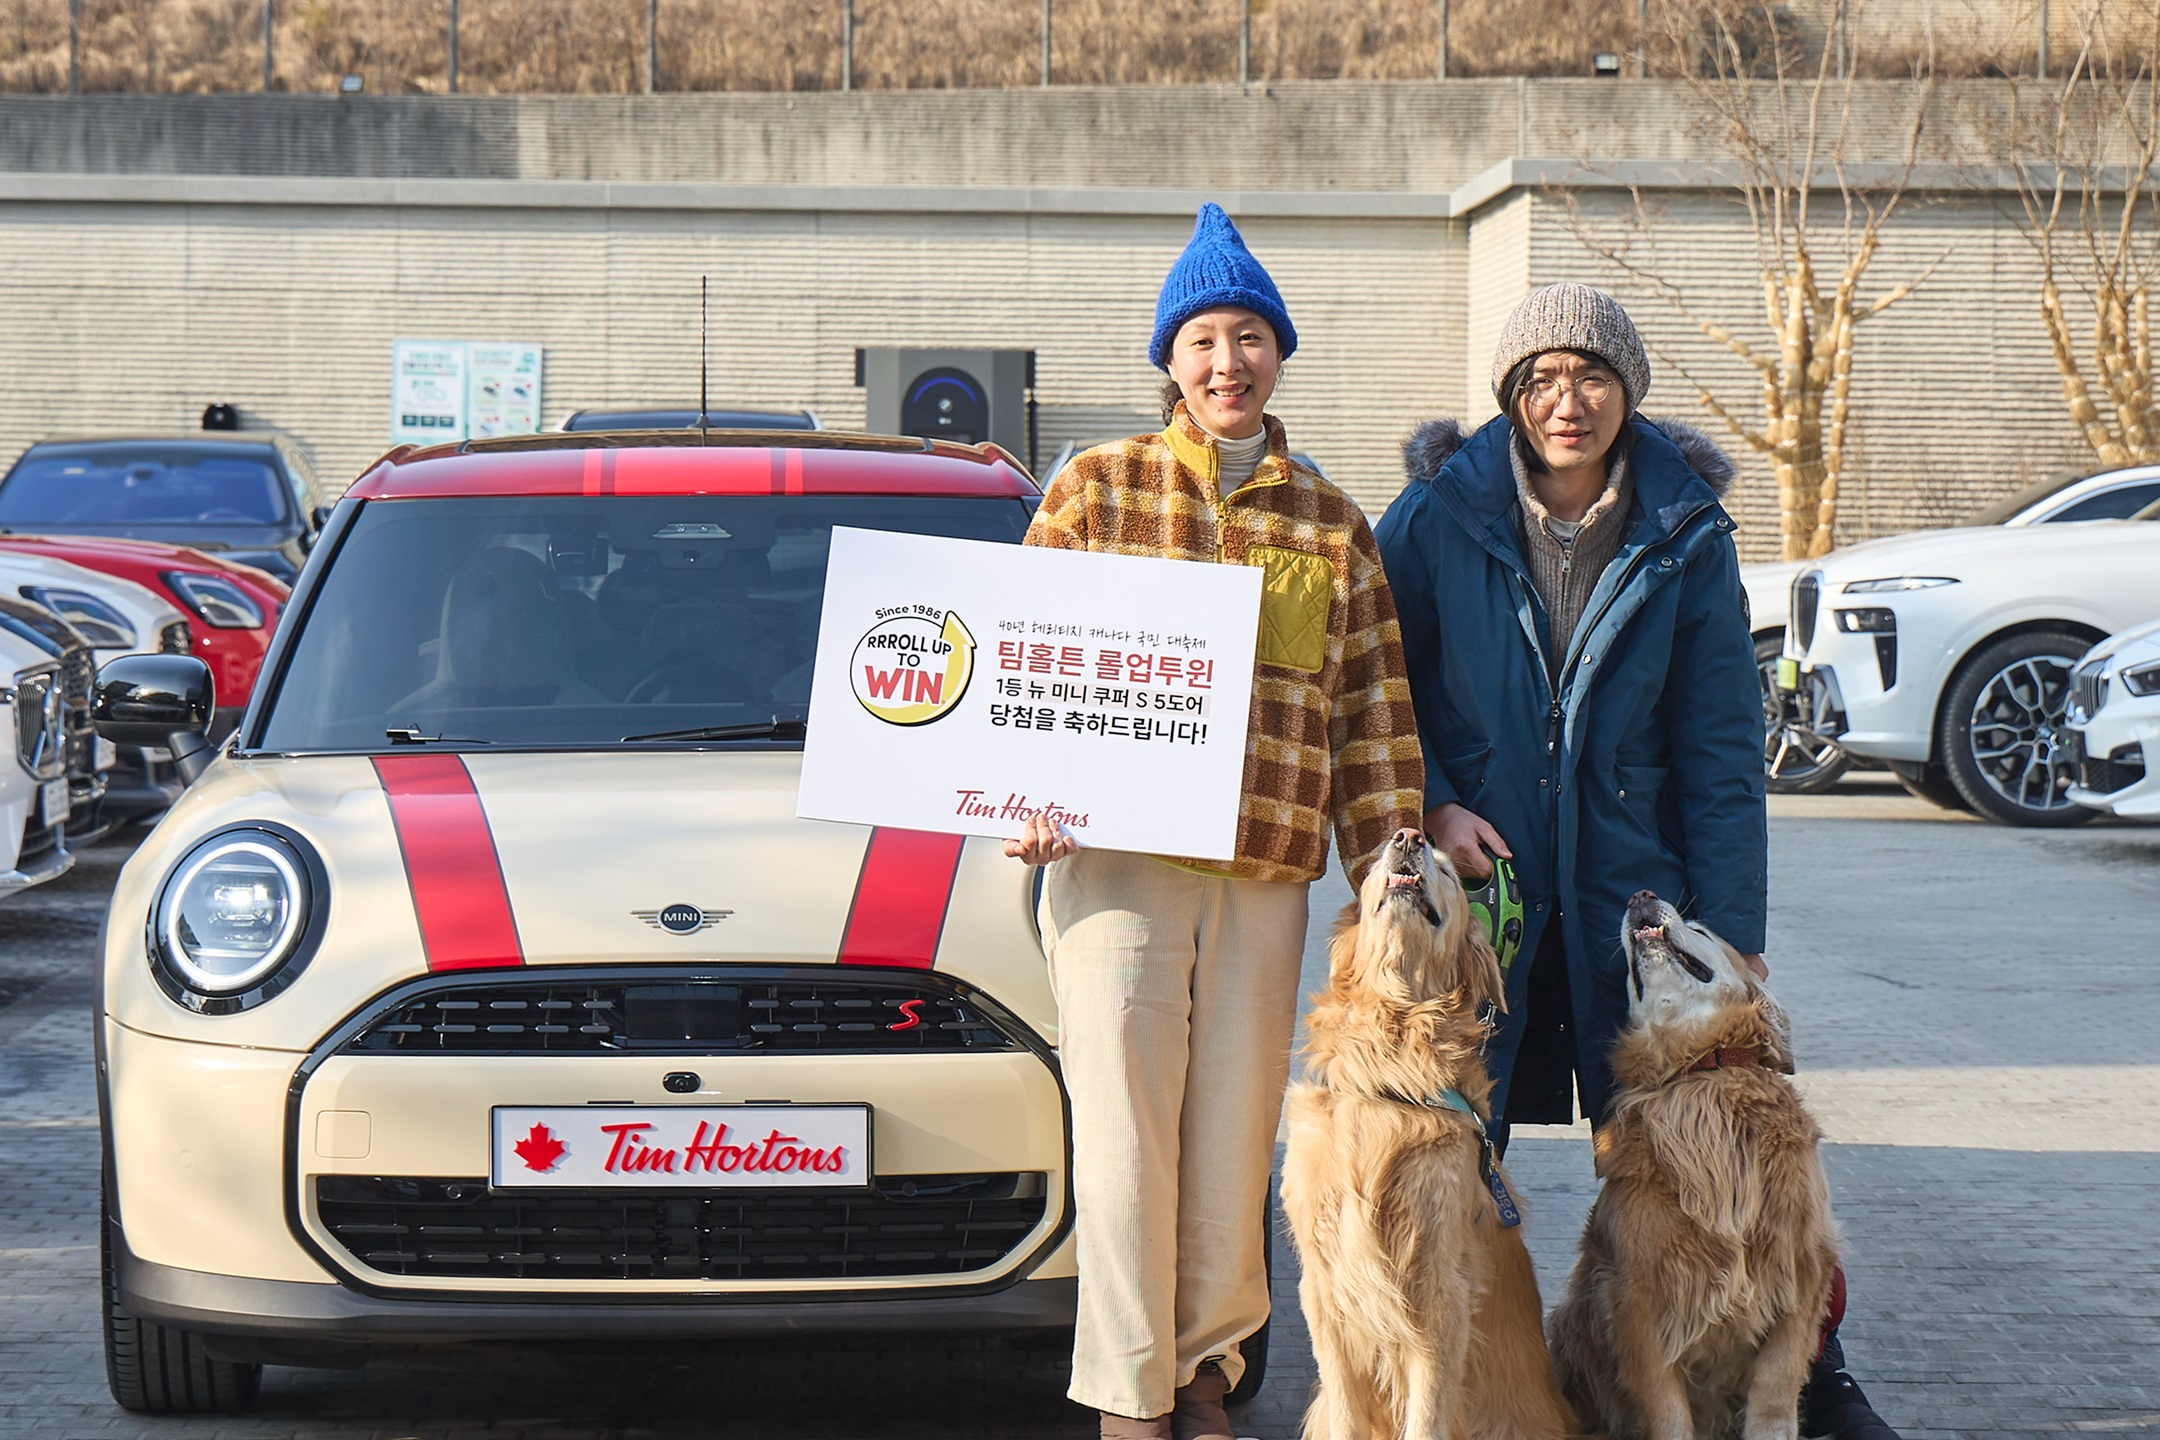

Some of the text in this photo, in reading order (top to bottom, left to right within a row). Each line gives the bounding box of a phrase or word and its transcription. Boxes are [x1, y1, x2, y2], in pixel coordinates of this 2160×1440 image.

[875, 604, 942, 619] Since 1986
[867, 634, 952, 655] RRROLL UP
[999, 620, 1206, 652] 40년 헤리티지 캐나다 국민 대축제
[897, 652, 921, 667] TO
[998, 641, 1213, 689] 팀홀튼 롤업투윈
[864, 665, 943, 704] WIN
[996, 678, 1203, 715] 1등 뉴 미니 쿠퍼 S 5도어
[990, 704, 1207, 745] 당첨을 축하드립니다!
[956, 790, 996, 819] Tim
[664, 912, 698, 922] MINI
[889, 999, 924, 1031] S
[600, 1119, 844, 1173] Tim Hortons
